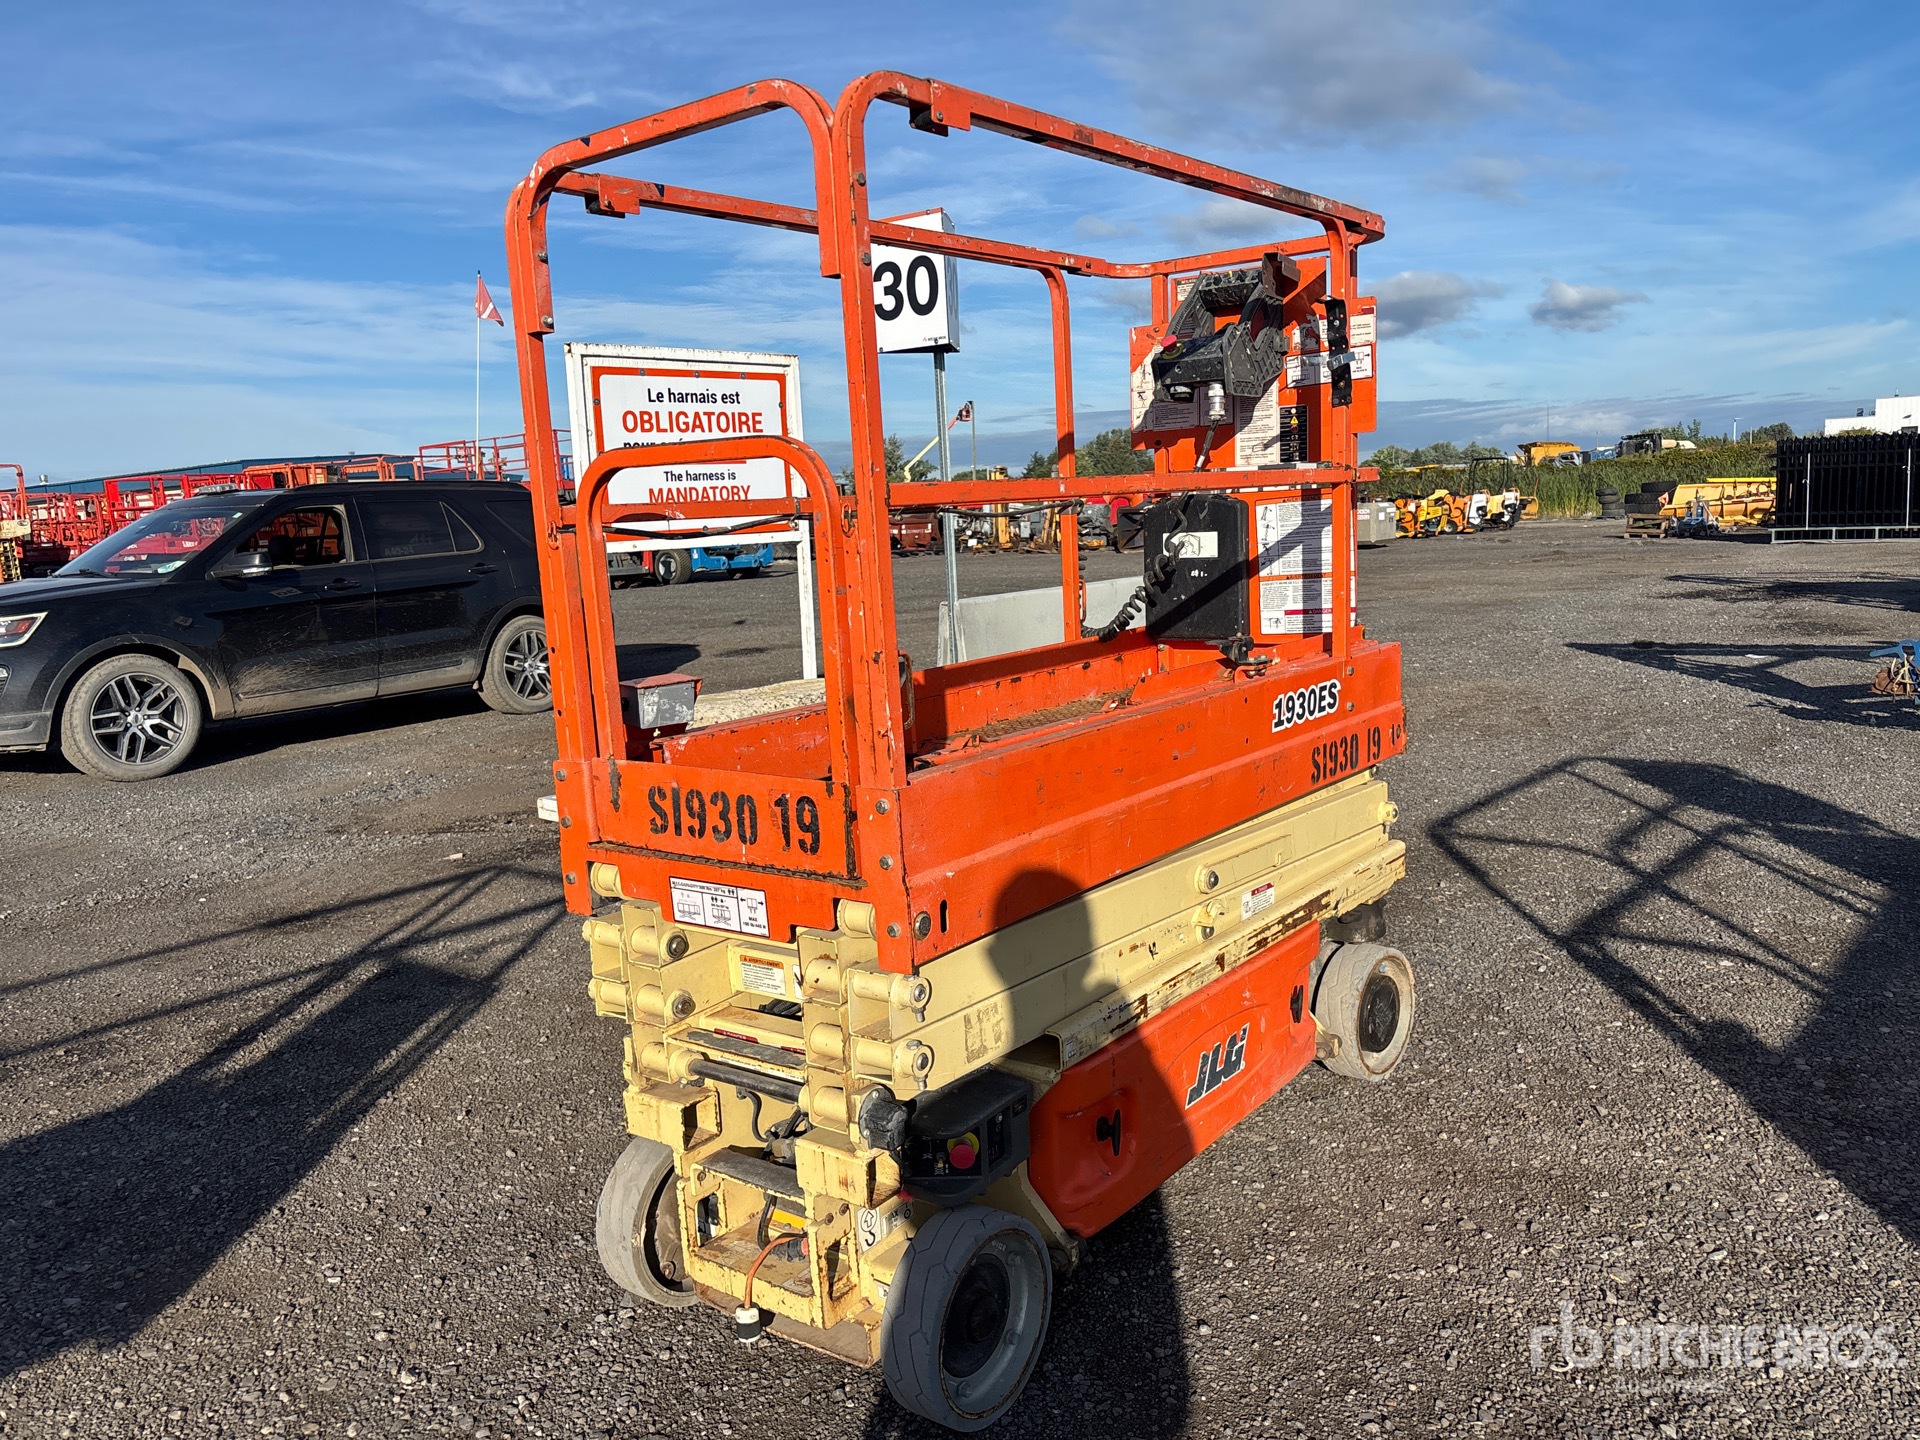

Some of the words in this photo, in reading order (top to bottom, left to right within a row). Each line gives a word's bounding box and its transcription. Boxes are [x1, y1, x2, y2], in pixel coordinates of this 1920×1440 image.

[873, 254, 939, 321] 30
[647, 387, 665, 403] Le
[667, 387, 718, 405] harnais
[721, 390, 741, 405] est
[621, 409, 764, 434] OBLIGATOIRE
[649, 484, 751, 504] MANDATORY
[664, 470, 684, 482] The
[685, 469, 725, 482] harness
[727, 469, 737, 481] is
[1273, 680, 1340, 730] 1930ES
[774, 792, 820, 856] 19
[1185, 1022, 1250, 1110] JLG
